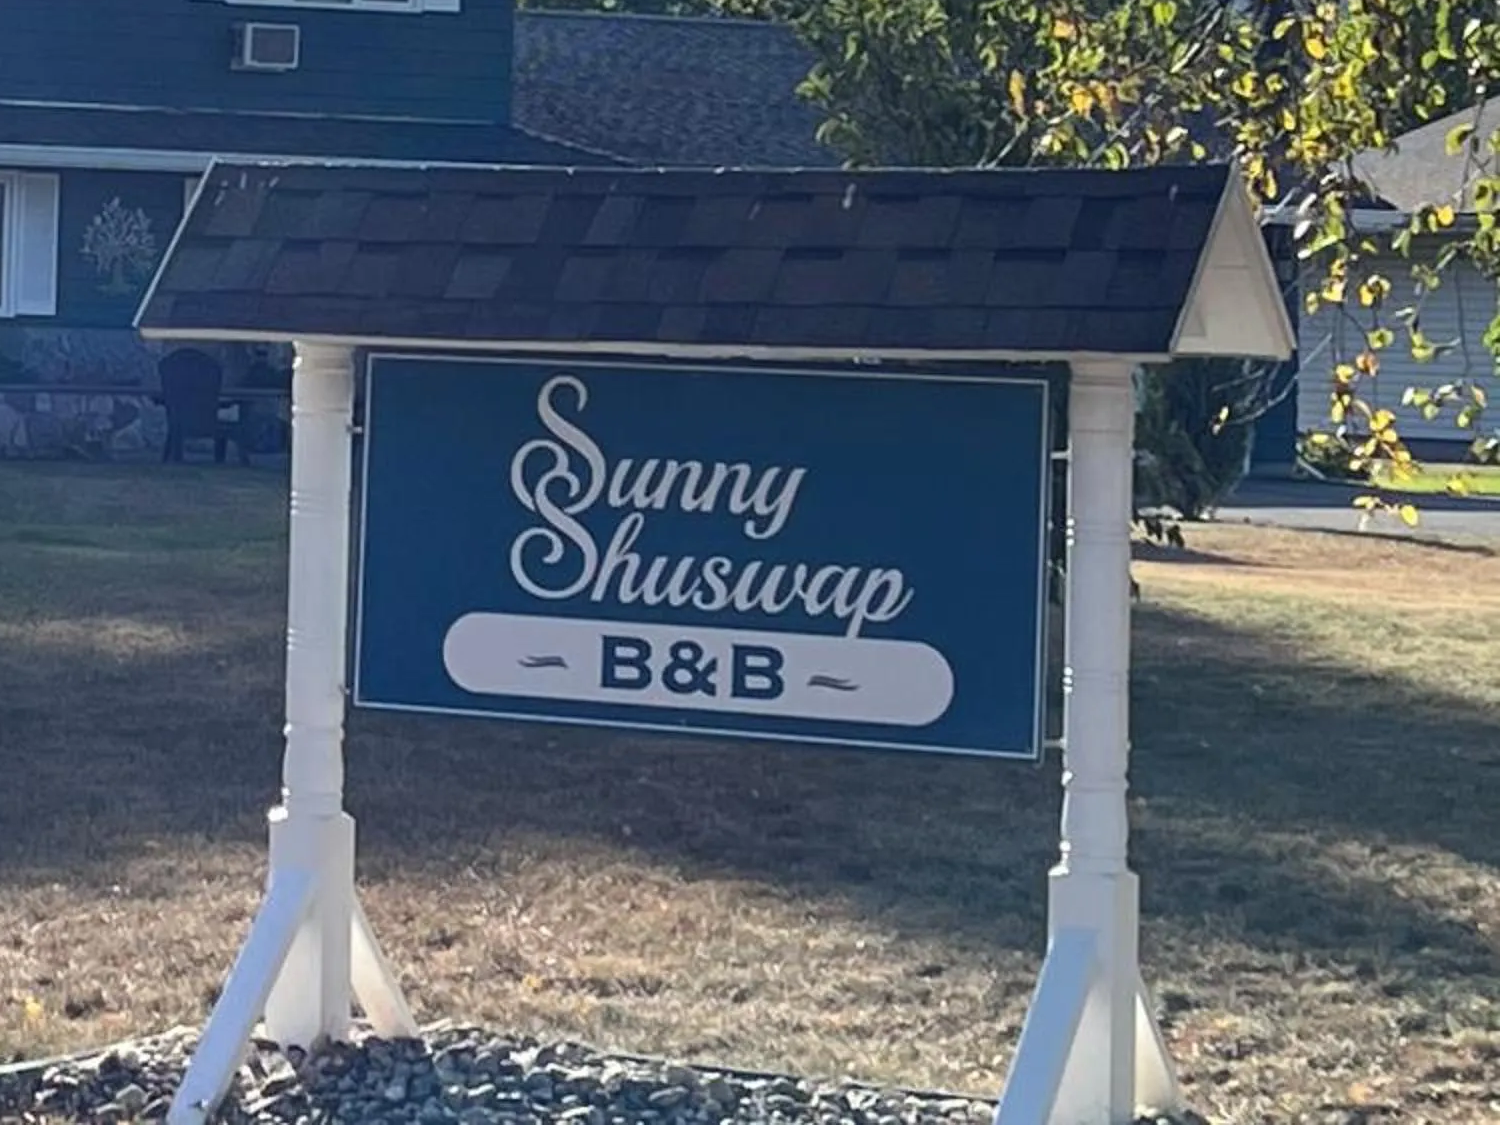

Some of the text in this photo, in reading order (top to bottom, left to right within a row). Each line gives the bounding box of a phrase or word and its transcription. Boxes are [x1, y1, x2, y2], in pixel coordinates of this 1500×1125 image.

[510, 375, 807, 539] Sunny
[510, 469, 914, 639] Shuswap
[600, 635, 786, 700] B&B
